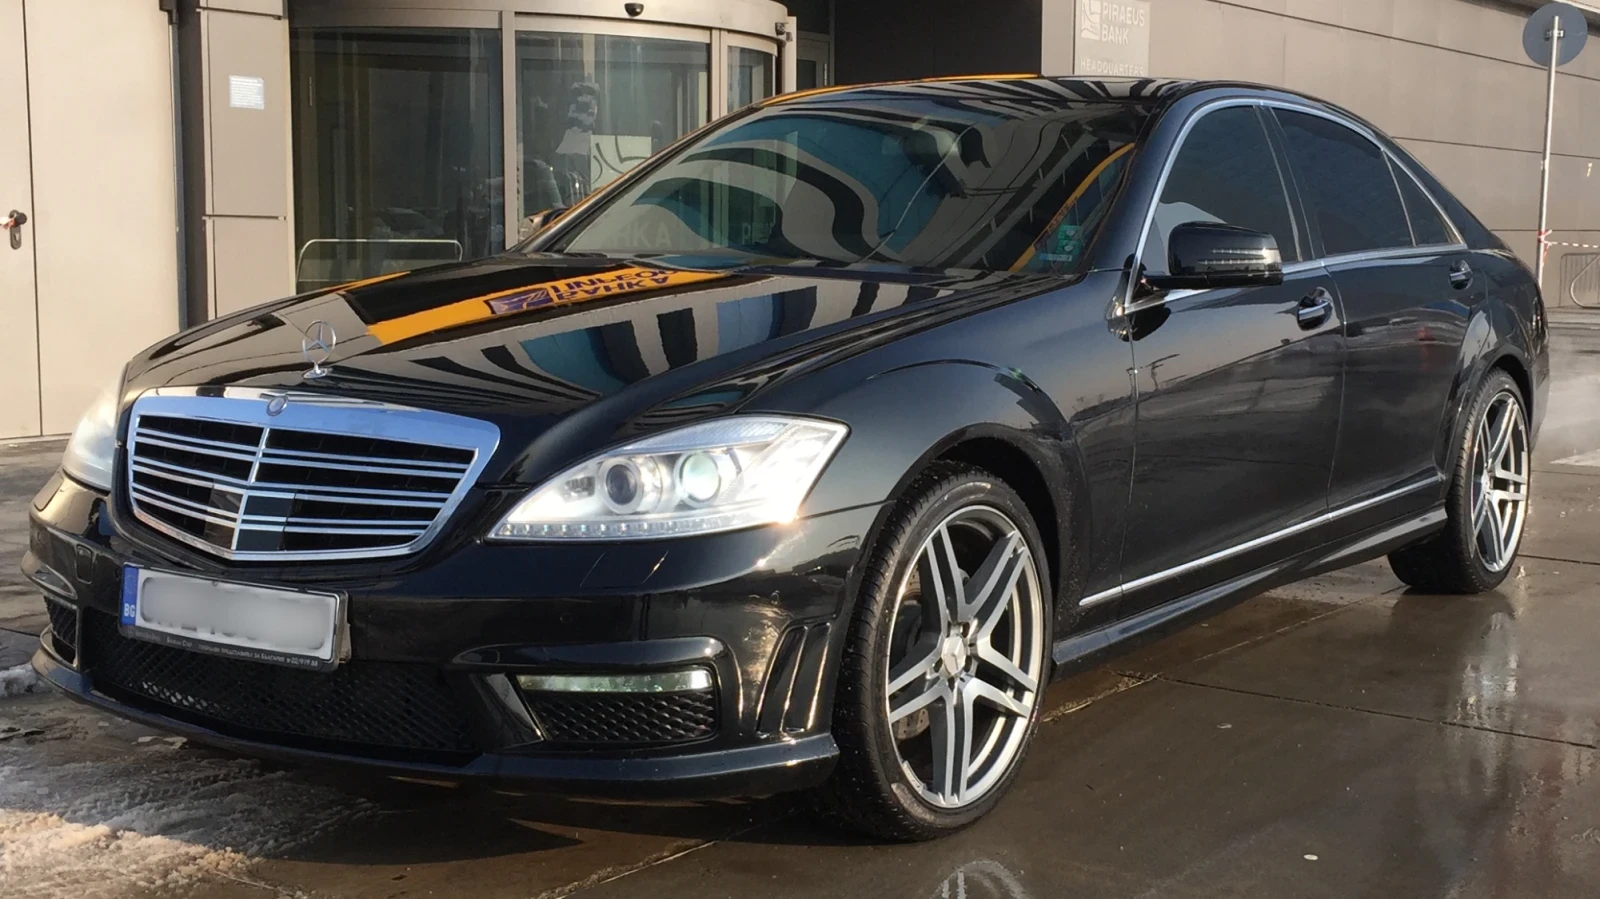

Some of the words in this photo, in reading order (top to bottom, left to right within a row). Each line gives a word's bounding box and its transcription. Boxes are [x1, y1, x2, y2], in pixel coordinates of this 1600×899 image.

[1102, 2, 1145, 27] PIRAEUS
[1101, 23, 1129, 44] BANK
[1080, 58, 1144, 76] HEADQUARTERS
[124, 603, 136, 618] BG
